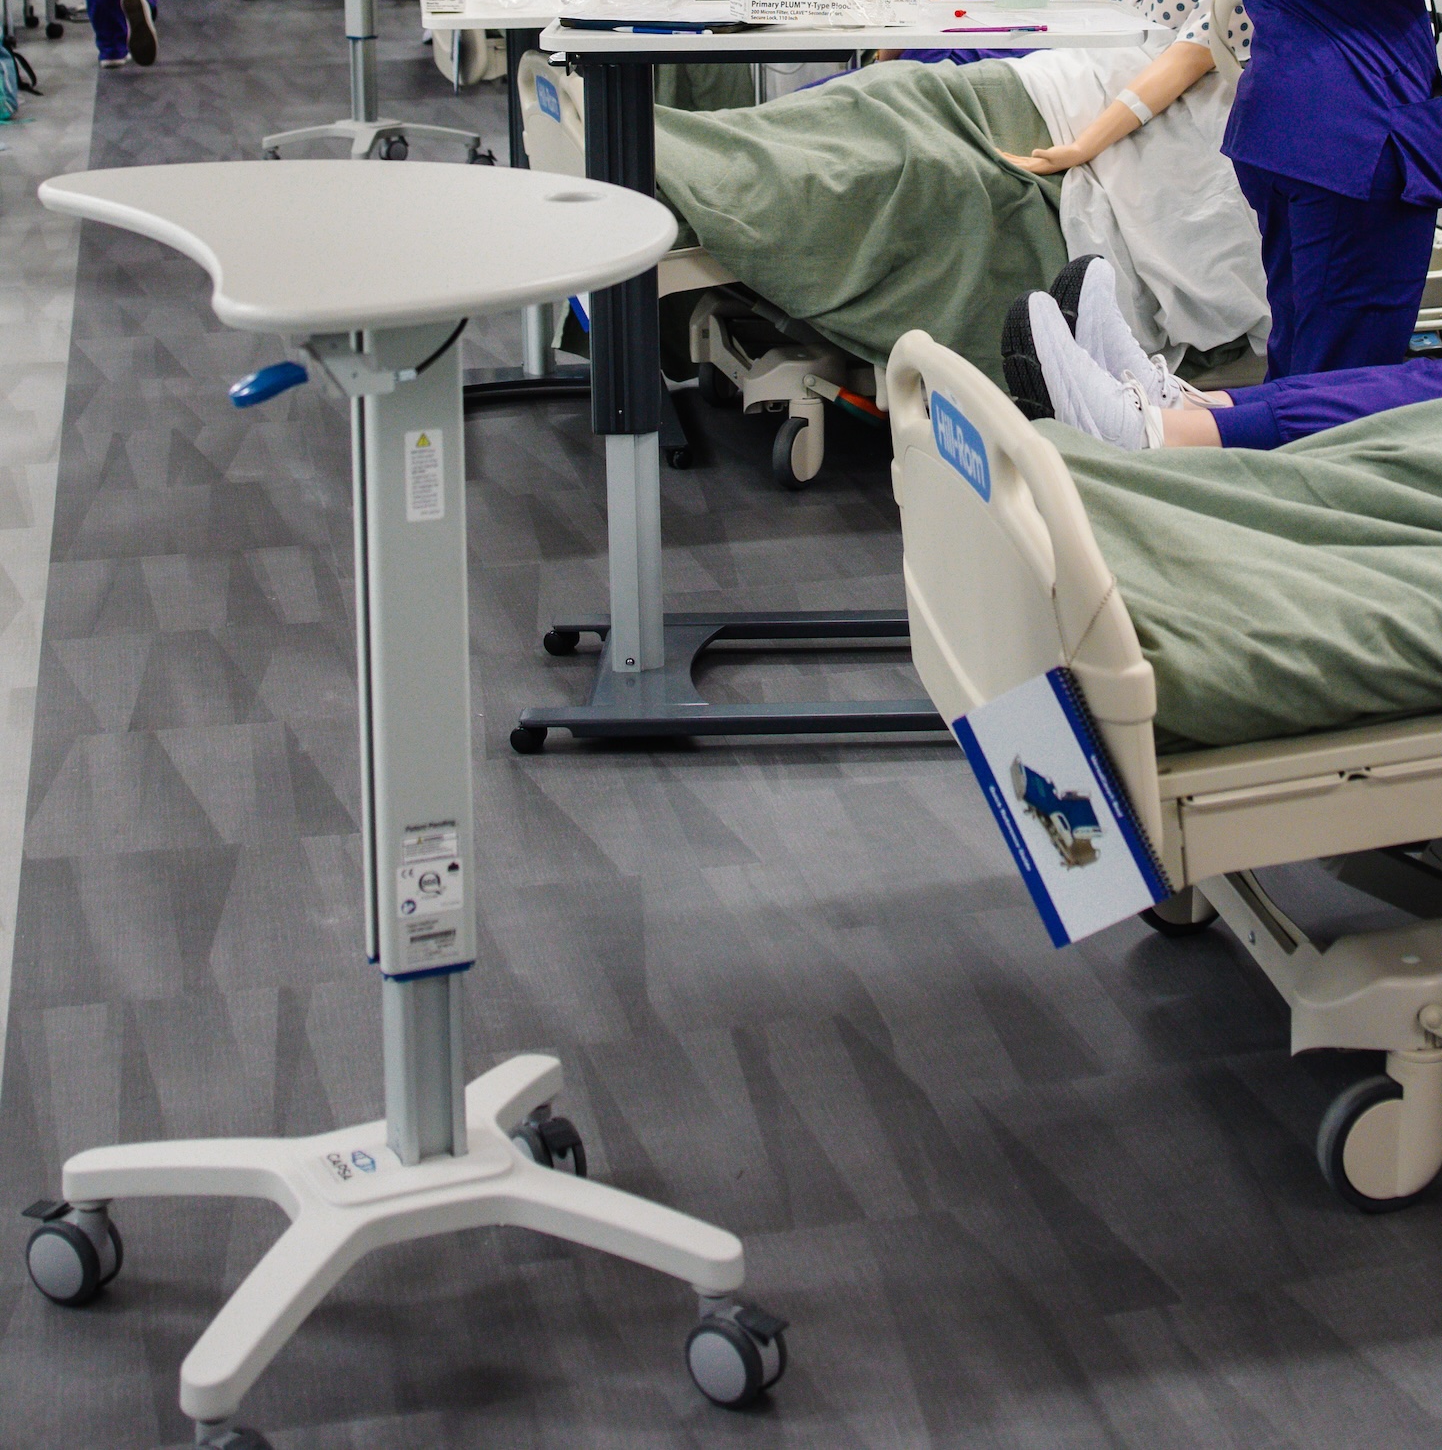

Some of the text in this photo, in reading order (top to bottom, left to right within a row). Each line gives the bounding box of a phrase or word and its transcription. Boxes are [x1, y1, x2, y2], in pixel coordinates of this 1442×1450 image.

[751, 1, 779, 9] Primary
[807, 2, 830, 10] Y-Type
[934, 403, 987, 490] Hill-Rom
